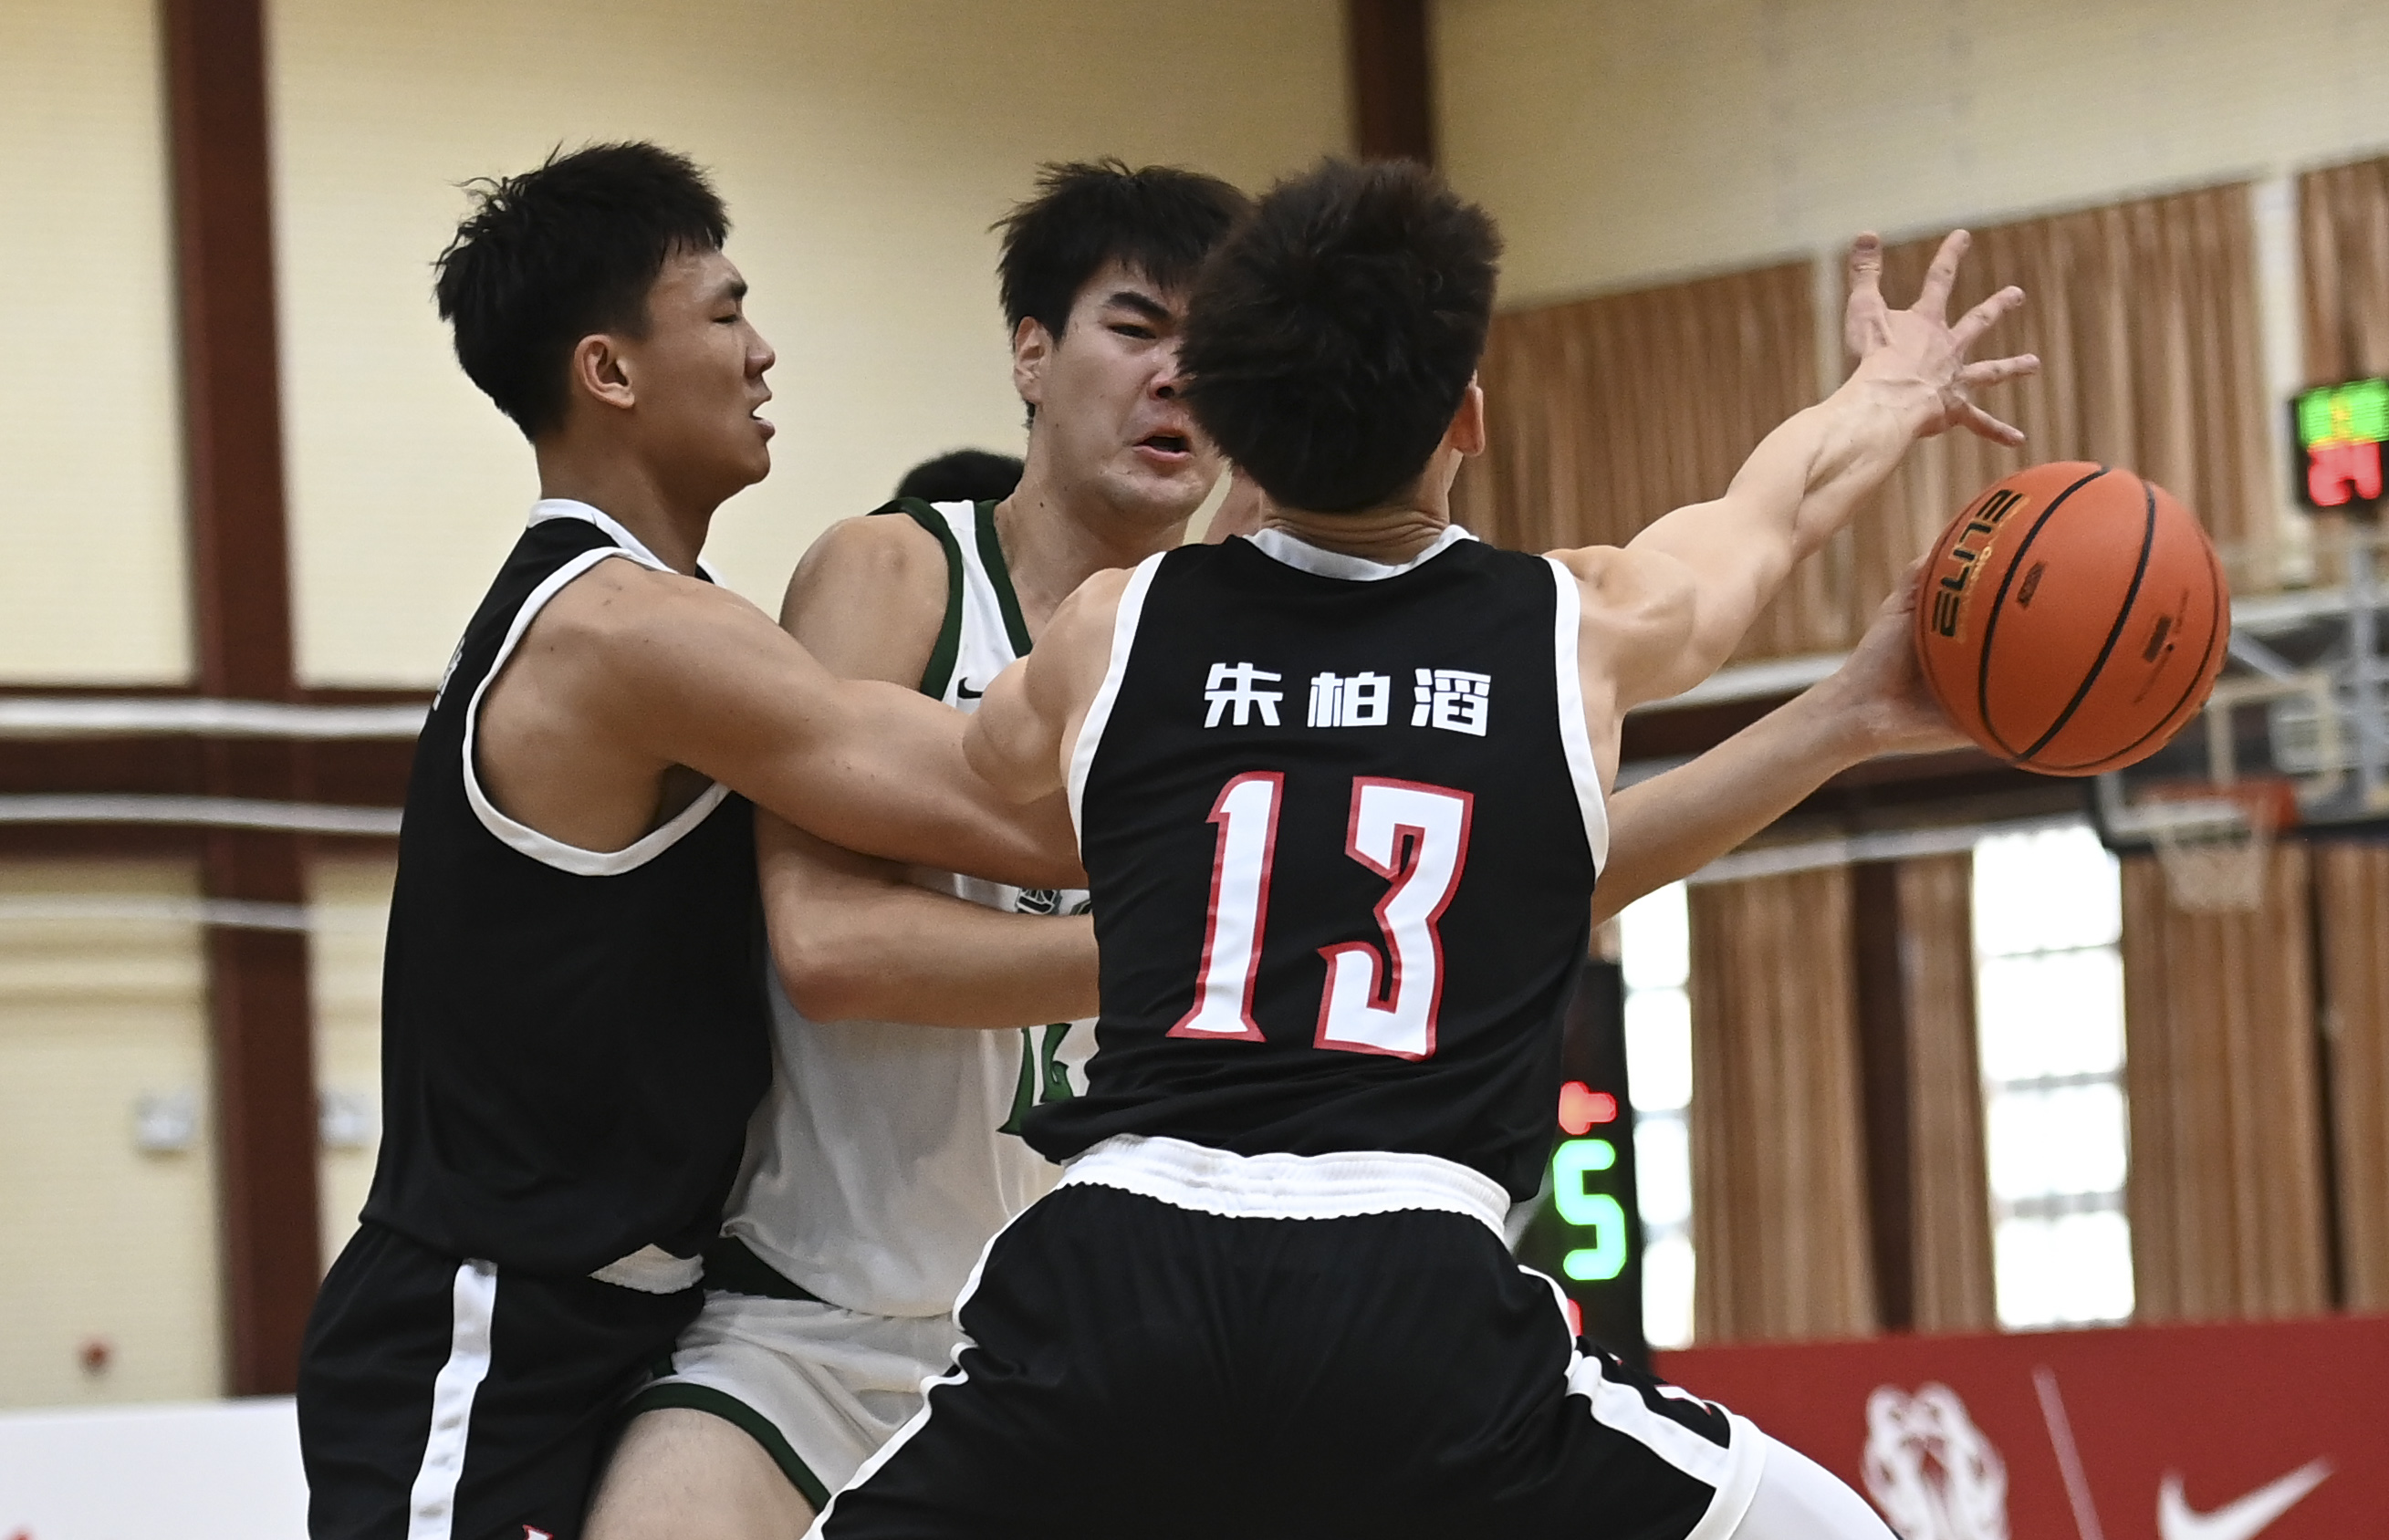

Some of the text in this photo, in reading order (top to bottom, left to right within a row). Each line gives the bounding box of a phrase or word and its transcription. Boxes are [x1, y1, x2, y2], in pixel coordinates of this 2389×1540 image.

[1931, 489, 2024, 638] ELITE
[1203, 661, 1492, 737] 朱柏滔
[1164, 770, 1476, 1063] 13
